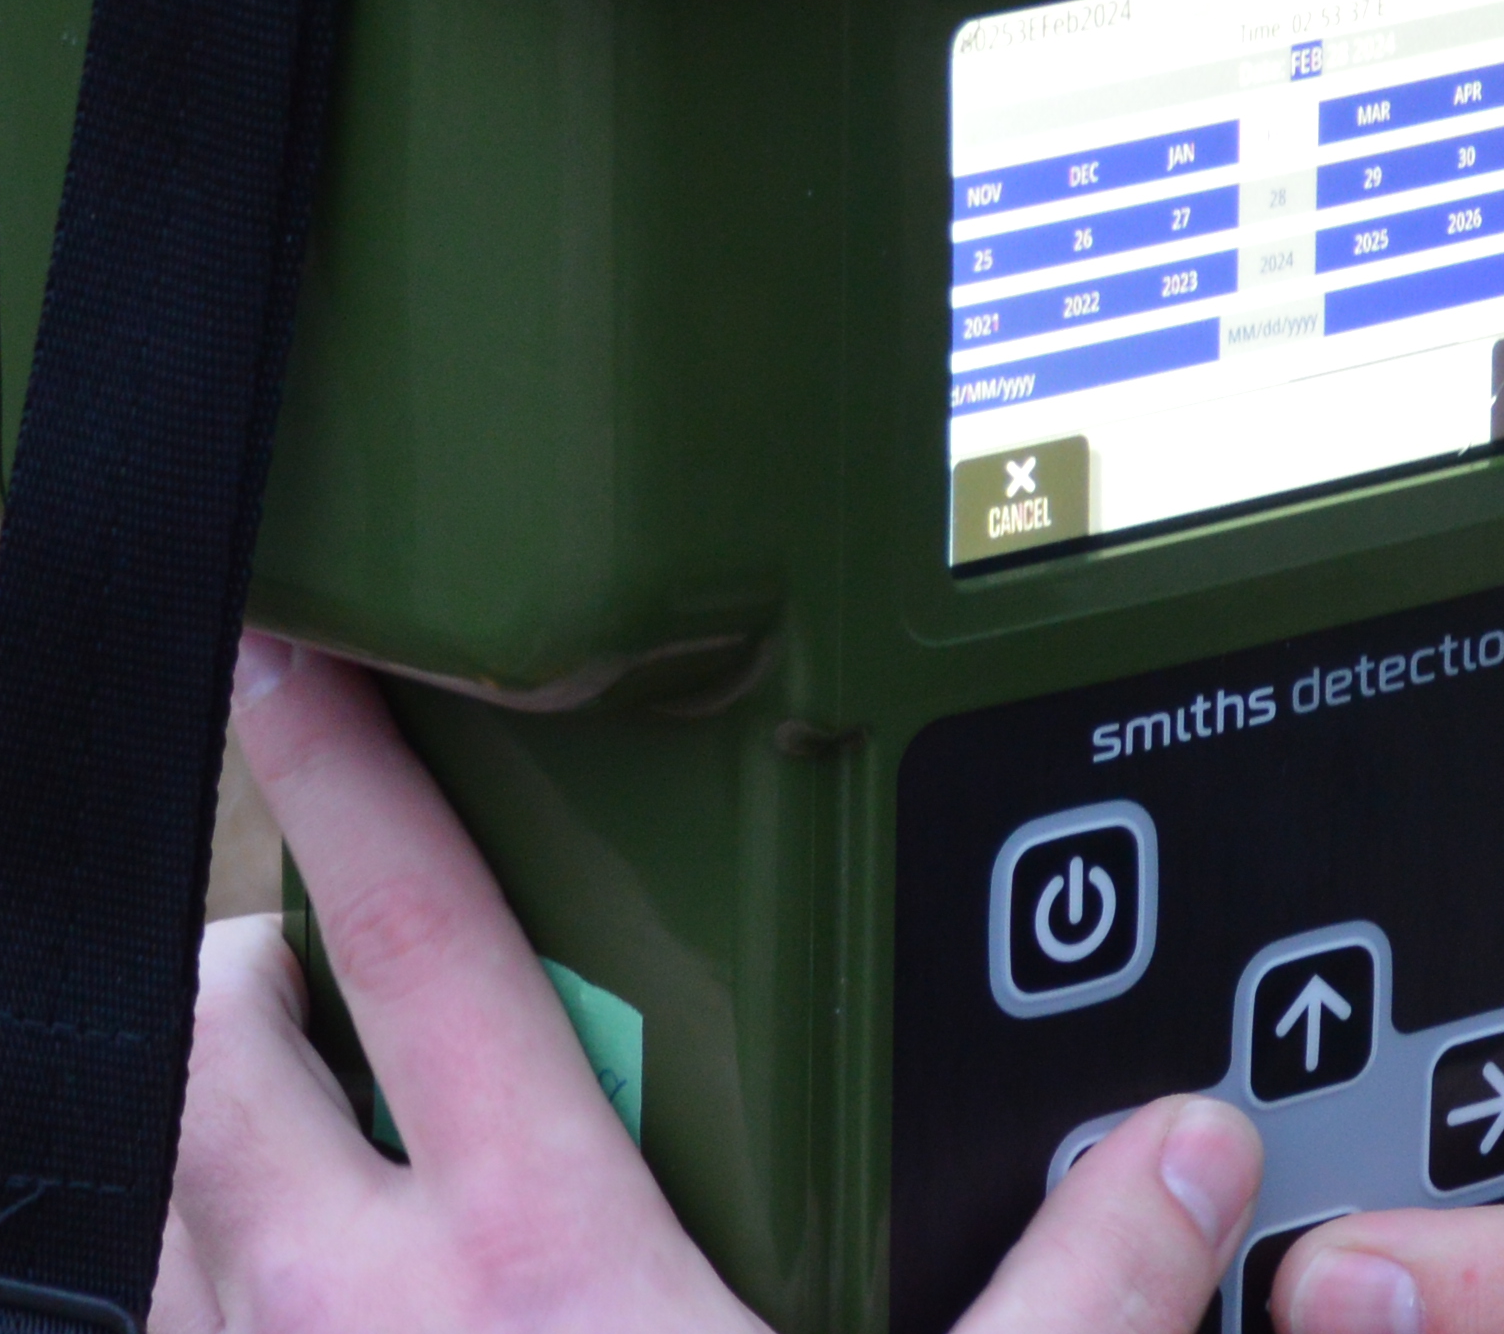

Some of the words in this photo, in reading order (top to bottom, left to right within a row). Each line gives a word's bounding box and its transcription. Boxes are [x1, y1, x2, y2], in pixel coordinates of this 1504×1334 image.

[1290, 46, 1324, 77] FEB
[966, 182, 1002, 208] NOV
[1068, 161, 1099, 188] DEC
[1167, 142, 1195, 168] JAN
[1356, 100, 1391, 126] MAR
[1453, 81, 1482, 106] APR
[973, 248, 993, 272] 25
[1073, 228, 1093, 252] 26
[1171, 206, 1191, 231] 27
[1268, 187, 1288, 210] 28
[1363, 166, 1383, 190] 29
[1457, 145, 1476, 169] 30
[963, 313, 999, 339] 2021
[1062, 291, 1100, 319] 2022
[1161, 270, 1198, 298] 2023
[1258, 250, 1295, 276] 2024
[1353, 228, 1390, 256] 2025
[1447, 207, 1483, 235] 2026
[1227, 311, 1319, 347] MM/dd/yyyy
[987, 496, 1052, 539] CANCEL
[1092, 685, 1278, 764] smiths
